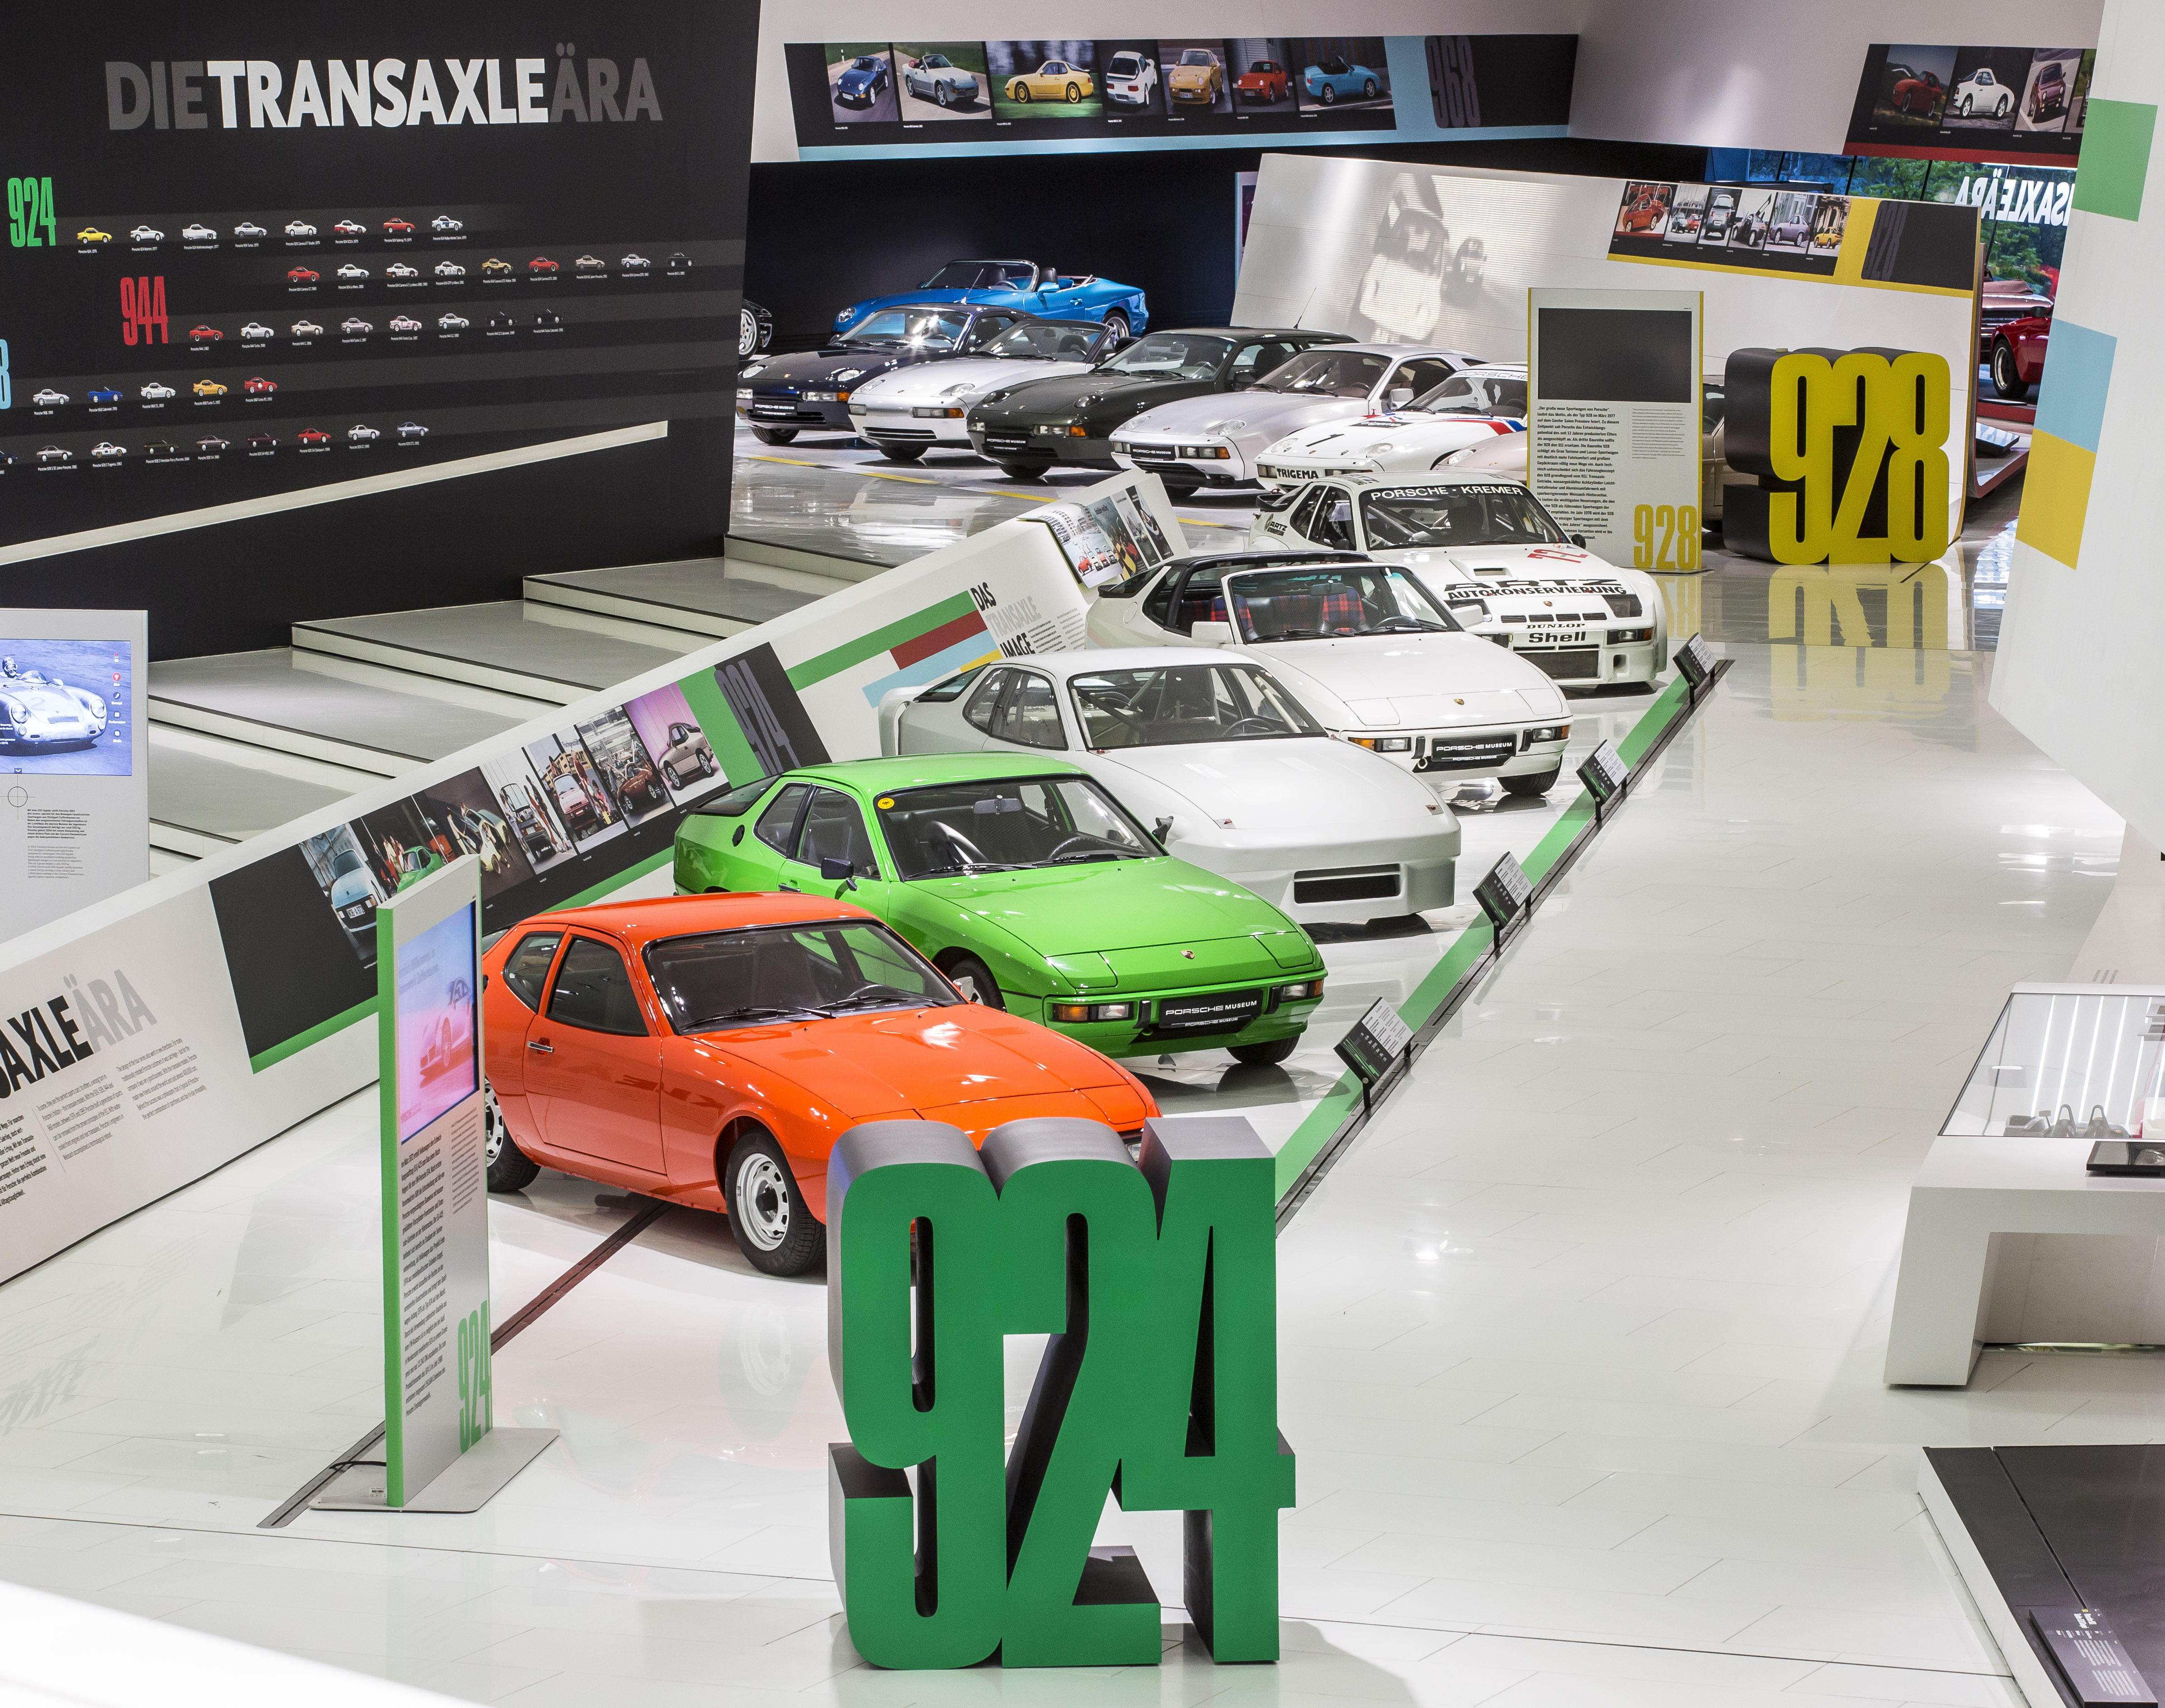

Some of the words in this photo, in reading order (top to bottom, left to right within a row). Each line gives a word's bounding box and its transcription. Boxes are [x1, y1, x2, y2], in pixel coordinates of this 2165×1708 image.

[1425, 35, 1481, 128] 968
[7, 177, 56, 247] 924
[120, 276, 169, 346] 944
[1277, 468, 1319, 479] TRIGEMA
[1770, 353, 1951, 565] 928
[1371, 486, 1449, 501] PORSCHE
[1461, 486, 1523, 495] KREMER
[1633, 504, 1698, 570] 928
[970, 582, 997, 612] DAS
[1445, 579, 1622, 591] ARTZ
[1448, 586, 1627, 599] AUTOKONSERVIERUNG
[985, 595, 1042, 639] TRANSAXLE
[999, 632, 1036, 658] IMAGE
[1529, 631, 1586, 643] Shell
[1166, 1005, 1224, 1016] PORSCHE
[1225, 1000, 1257, 1010] MUSEUM
[457, 1299, 493, 1454] 924
[842, 1158, 1296, 1670] 924
